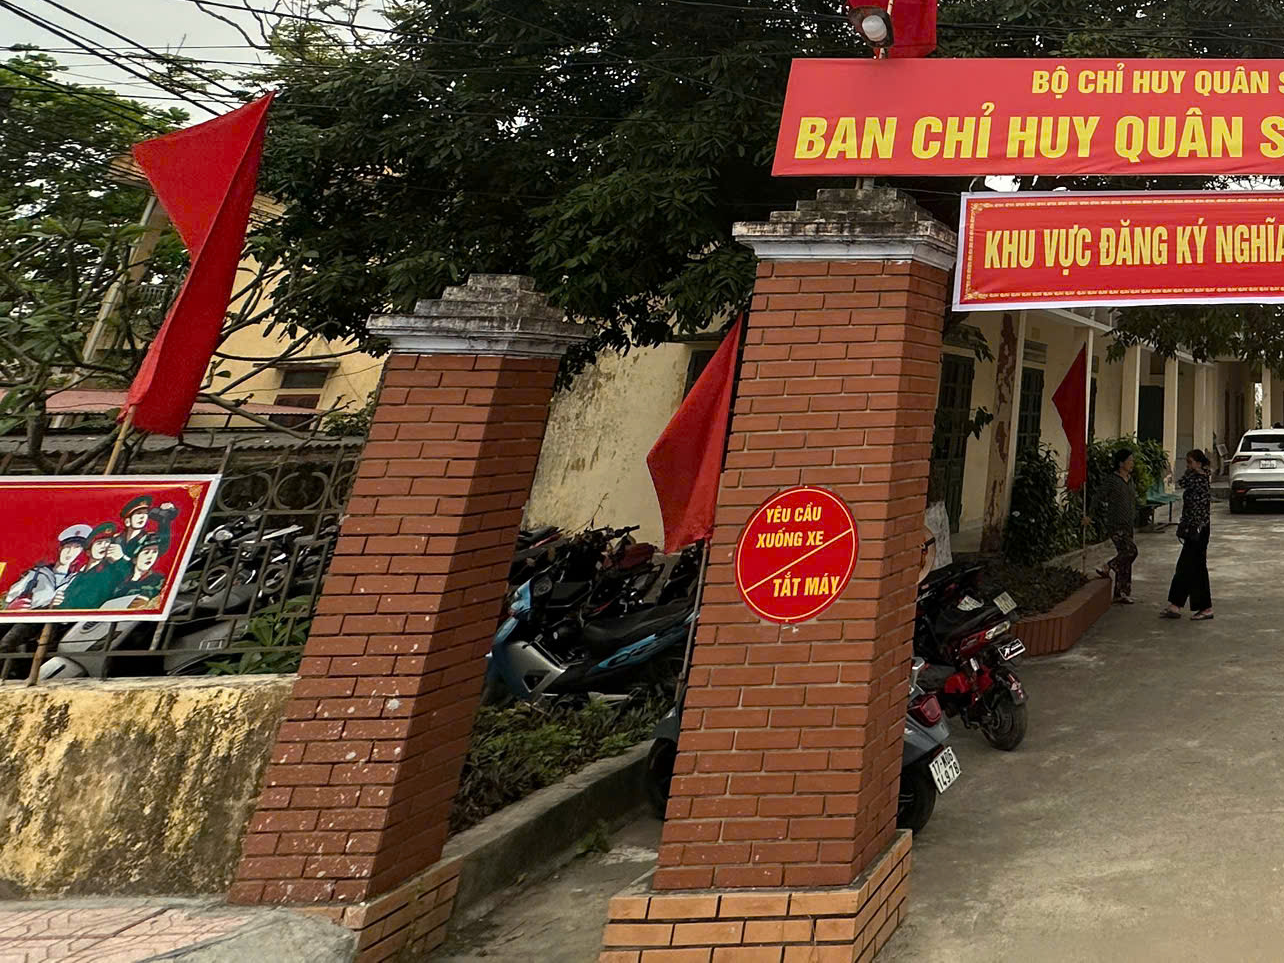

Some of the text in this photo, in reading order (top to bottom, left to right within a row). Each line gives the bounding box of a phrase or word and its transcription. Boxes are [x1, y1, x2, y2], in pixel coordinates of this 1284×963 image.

[1031, 65, 1070, 100] BỘ
[1077, 62, 1125, 94] CHỈ
[1131, 70, 1187, 94] HUY
[1194, 65, 1270, 97] QUÂN
[793, 116, 898, 160] BAN
[911, 101, 996, 160] CHỈ
[1005, 116, 1101, 159] HUY
[1114, 107, 1244, 163] QUÂN
[983, 228, 1036, 269] KHU
[1043, 224, 1092, 276] VỰC
[1098, 219, 1169, 266] ĐĂNG
[1176, 217, 1209, 265] KÝ
[766, 502, 822, 524] YÊU CẦU
[755, 527, 825, 549] XUỐNG XE
[773, 572, 840, 597] TẮT MÁY
